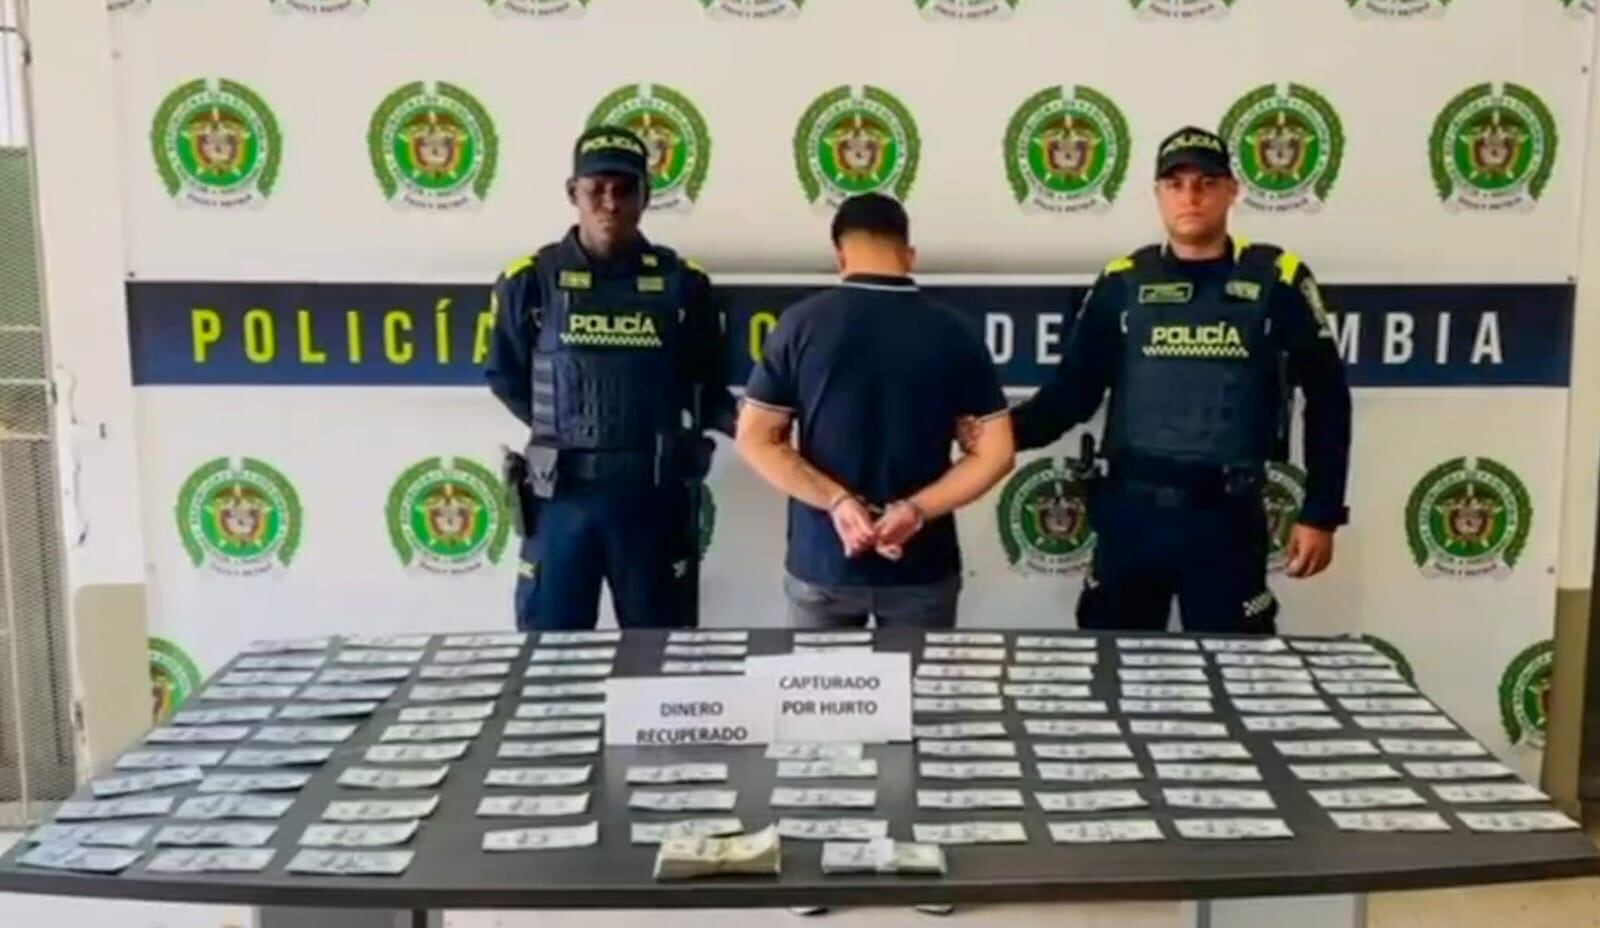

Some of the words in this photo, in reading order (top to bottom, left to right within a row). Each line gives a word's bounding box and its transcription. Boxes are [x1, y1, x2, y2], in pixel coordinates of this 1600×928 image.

[569, 311, 655, 335] POLICÍA
[985, 312, 1063, 364] DE
[1324, 312, 1503, 364] MBIA
[1151, 321, 1240, 345] POLICÍA
[779, 675, 880, 690] CAPTURADO
[660, 702, 723, 718] DINERO
[781, 700, 815, 715] POR
[820, 700, 878, 715] HURTO
[636, 725, 748, 744] RECUPERADO
